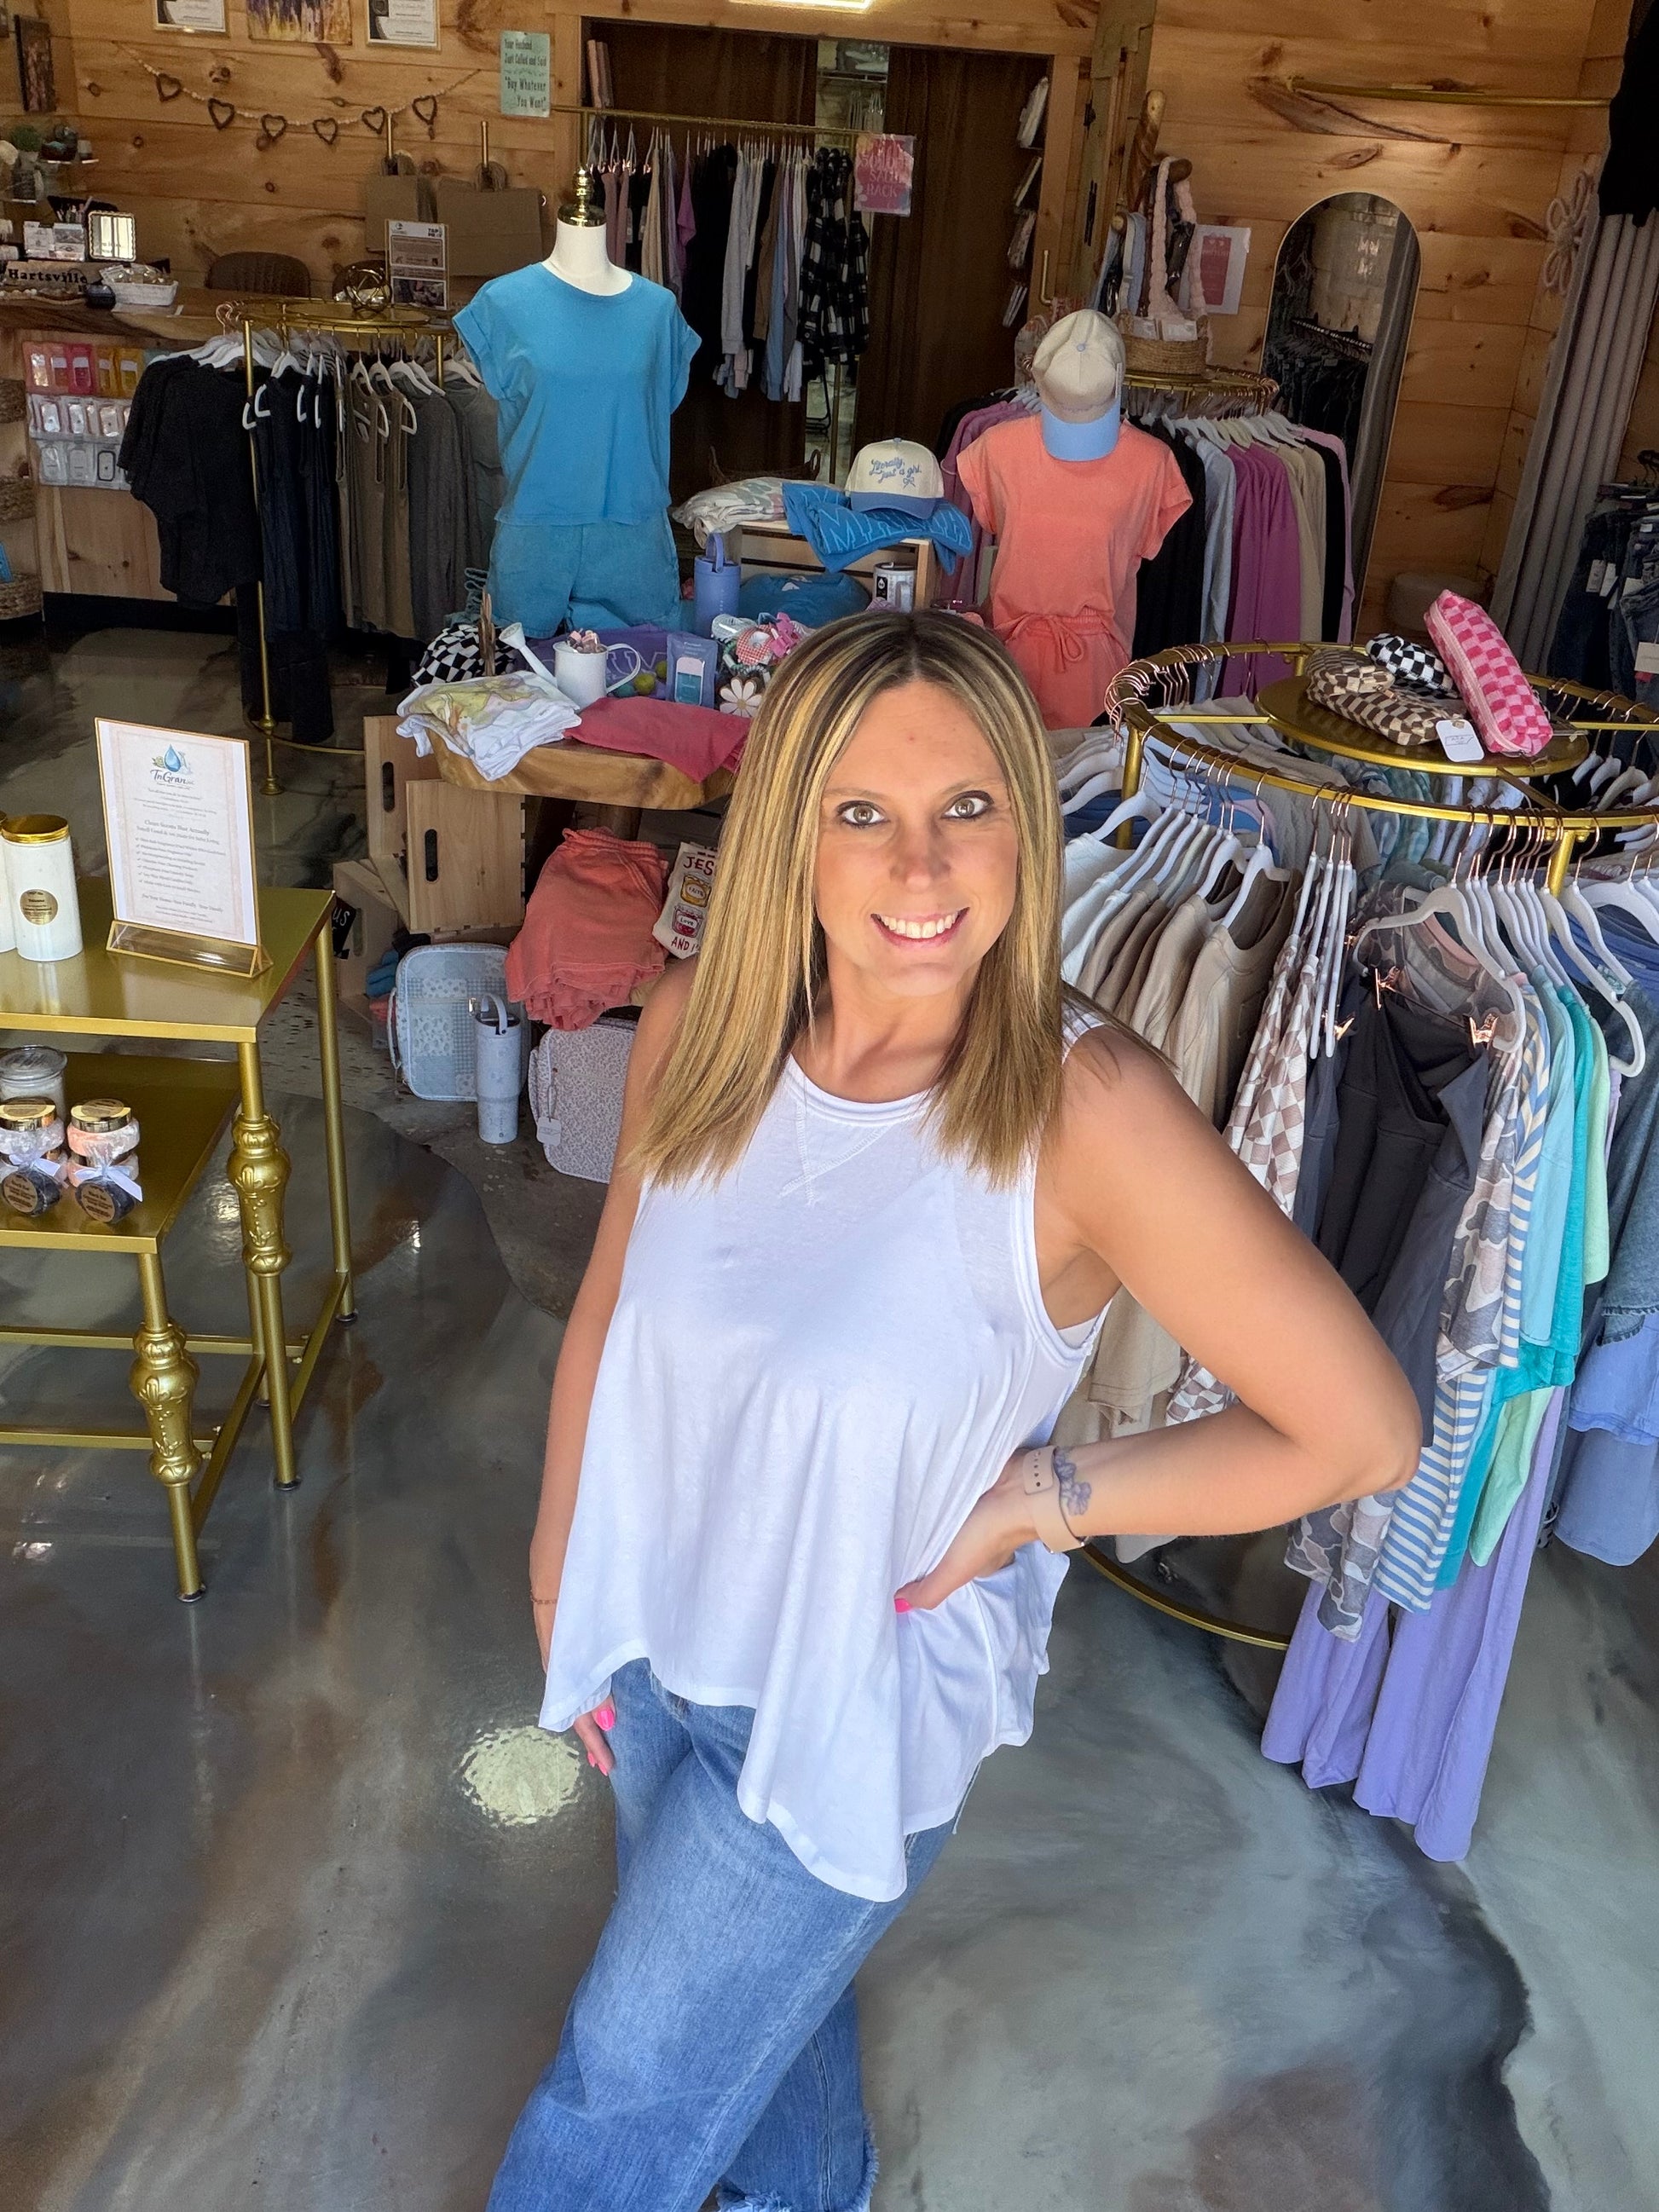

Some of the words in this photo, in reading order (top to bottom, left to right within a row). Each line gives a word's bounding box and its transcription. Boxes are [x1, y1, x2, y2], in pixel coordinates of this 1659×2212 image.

[517, 95, 527, 107] You
[9, 269, 88, 284] Hartsville
[683, 856, 714, 876] JES
[671, 936, 690, 950] AND
